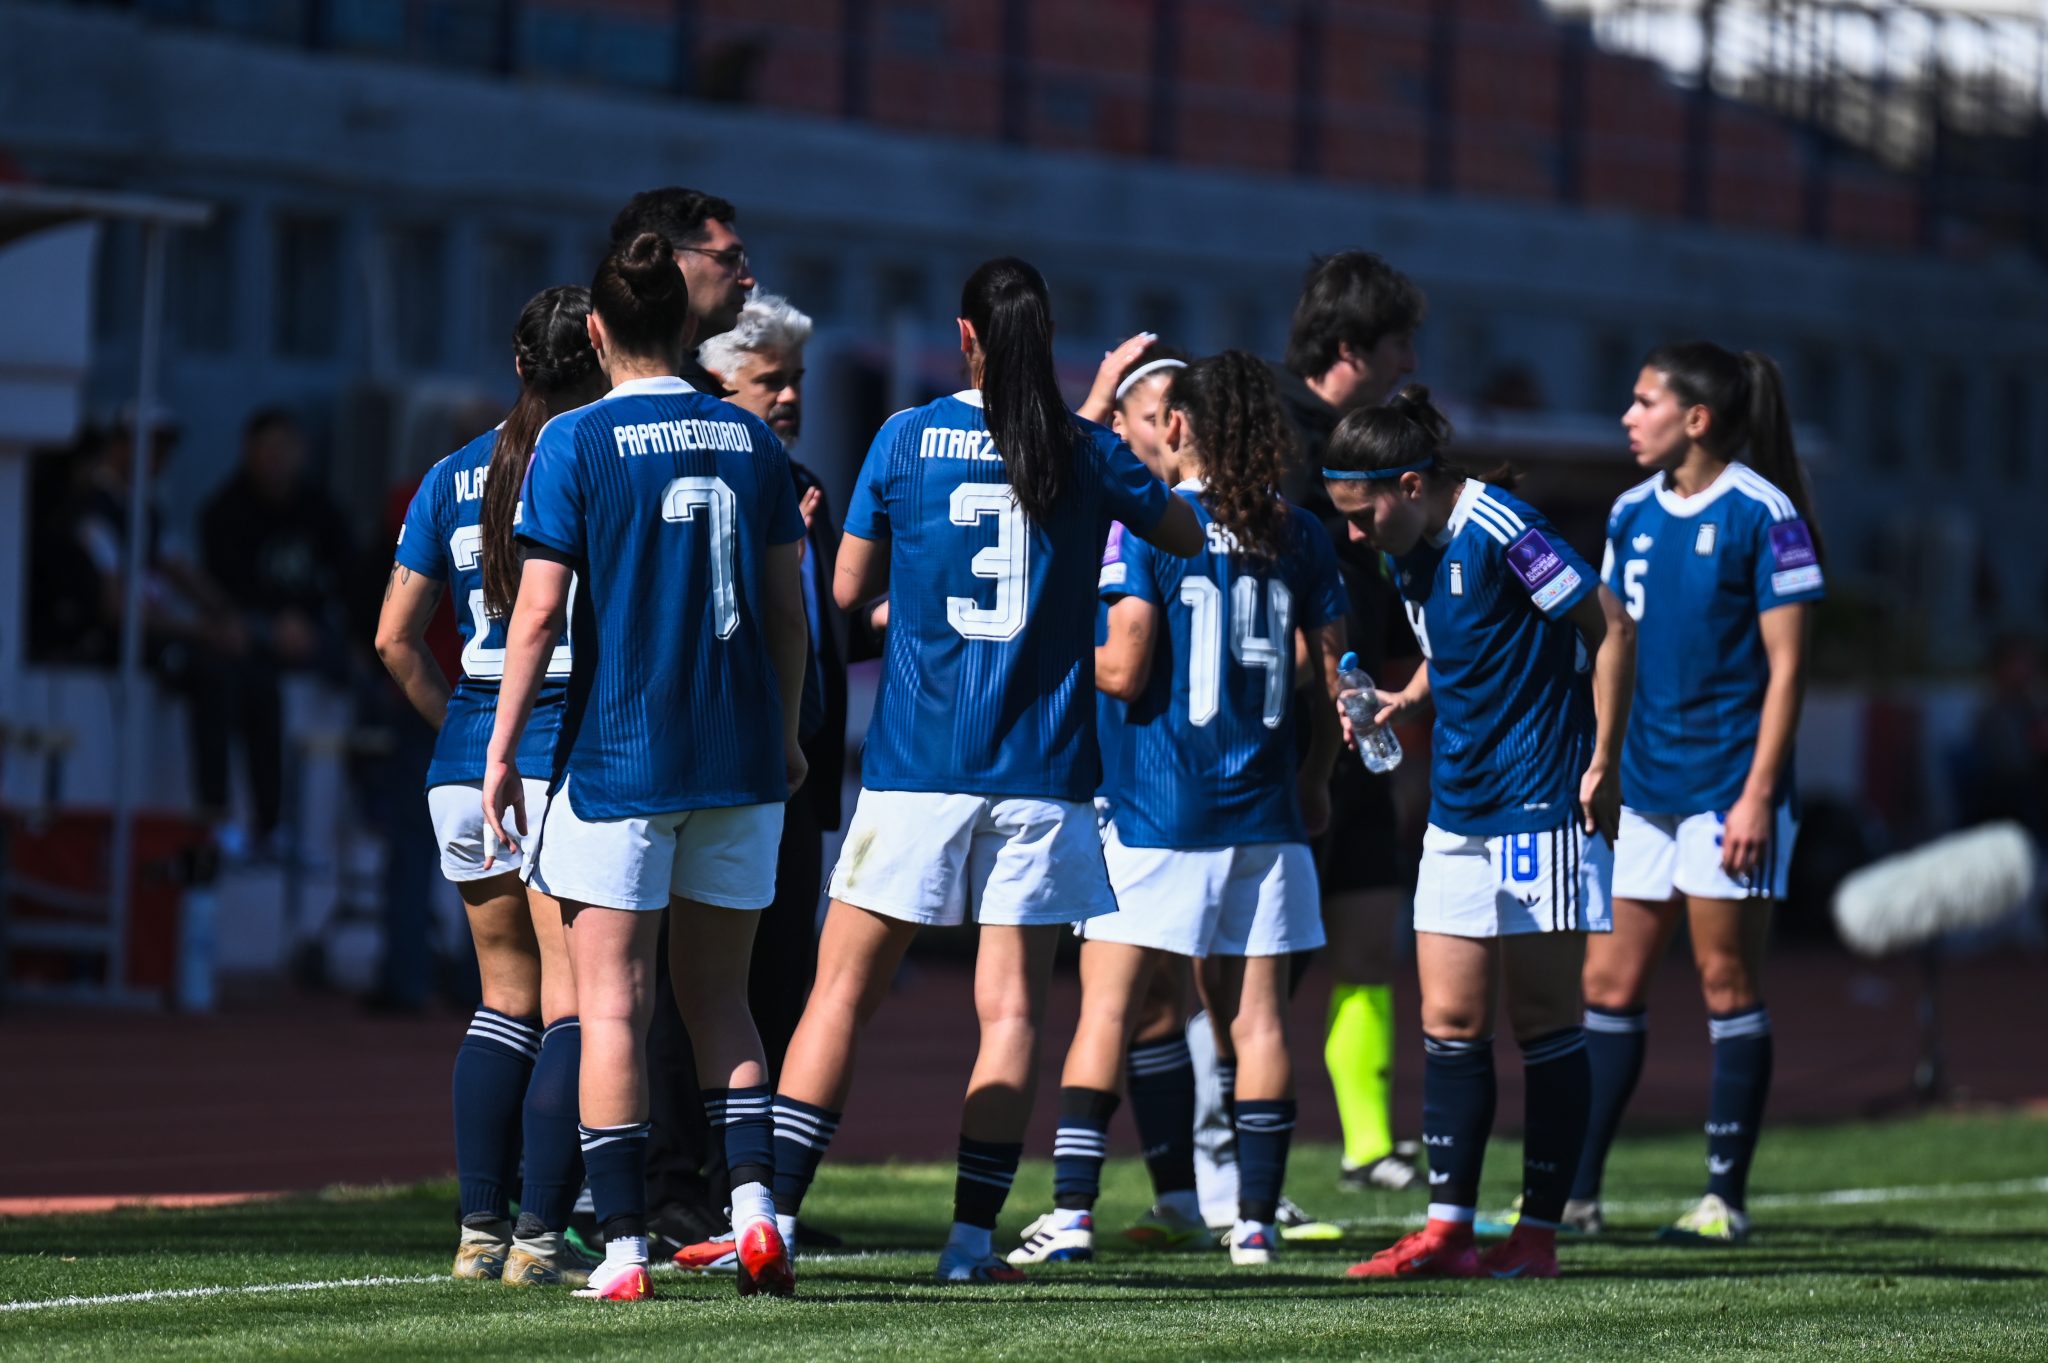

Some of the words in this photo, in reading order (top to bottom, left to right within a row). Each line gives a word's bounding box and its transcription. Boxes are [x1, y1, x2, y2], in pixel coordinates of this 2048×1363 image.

[613, 418, 752, 457] PAPATHEODOROU
[920, 427, 1003, 461] NTARZ
[661, 476, 740, 640] 7
[946, 482, 1030, 641] 3
[1624, 559, 1648, 621] 5
[1180, 575, 1292, 729] 14
